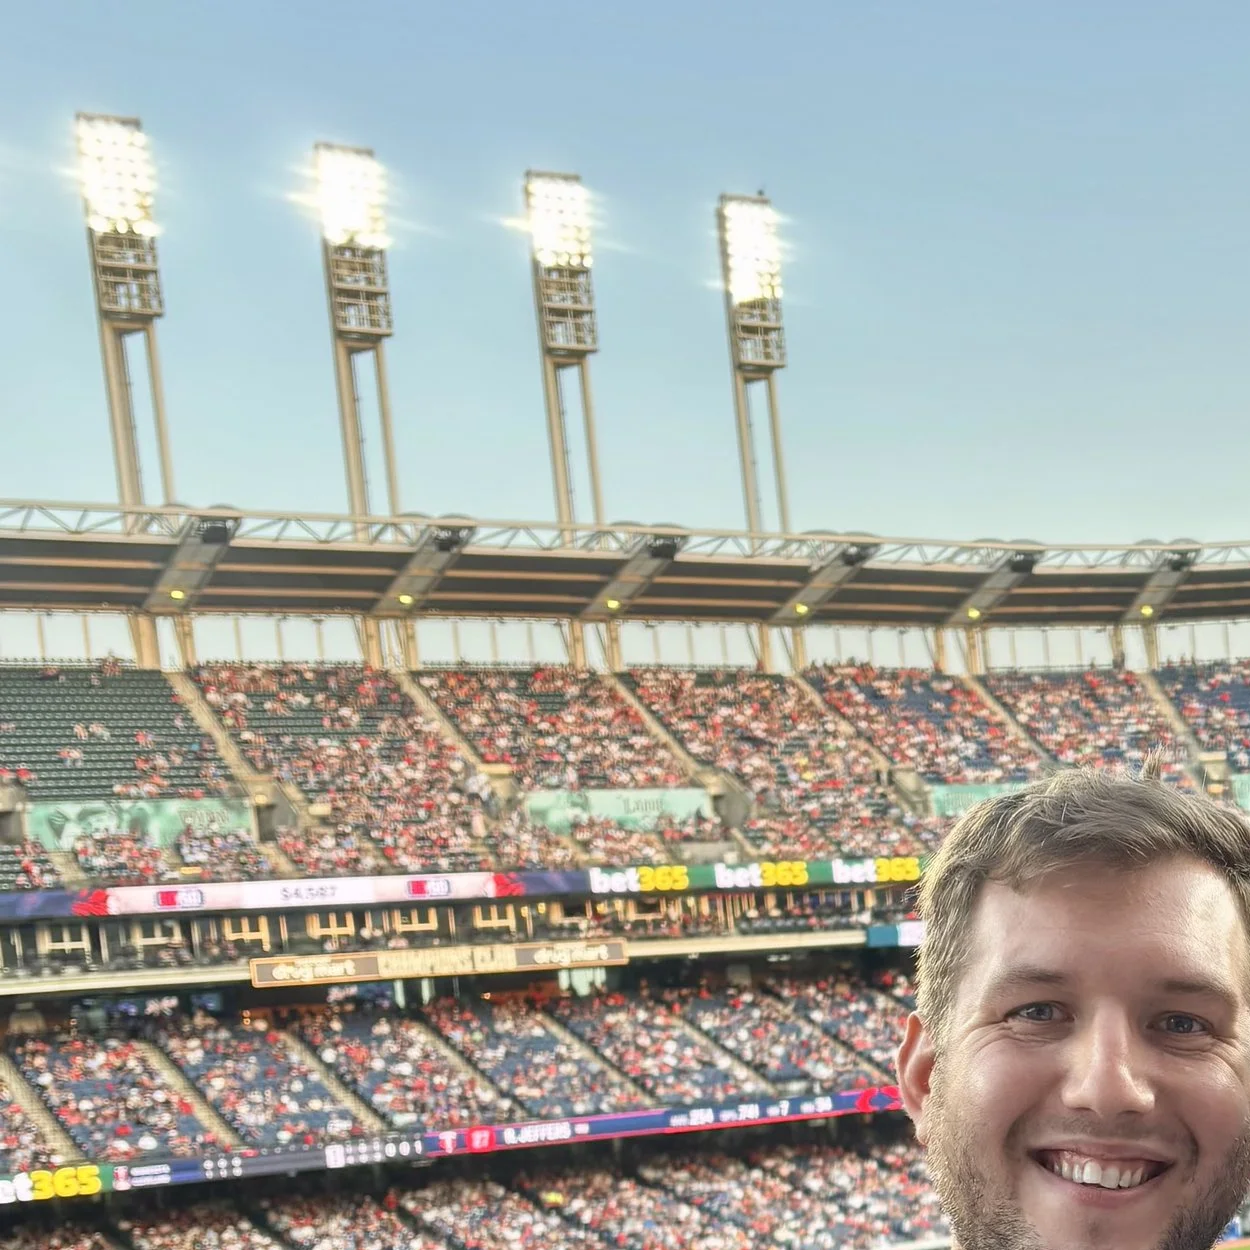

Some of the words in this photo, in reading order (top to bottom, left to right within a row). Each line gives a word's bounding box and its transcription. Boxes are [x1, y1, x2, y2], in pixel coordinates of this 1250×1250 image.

[589, 866, 689, 893] bet365
[714, 861, 808, 888] bet365
[832, 857, 920, 883] bet365
[0, 1165, 101, 1204] et365
